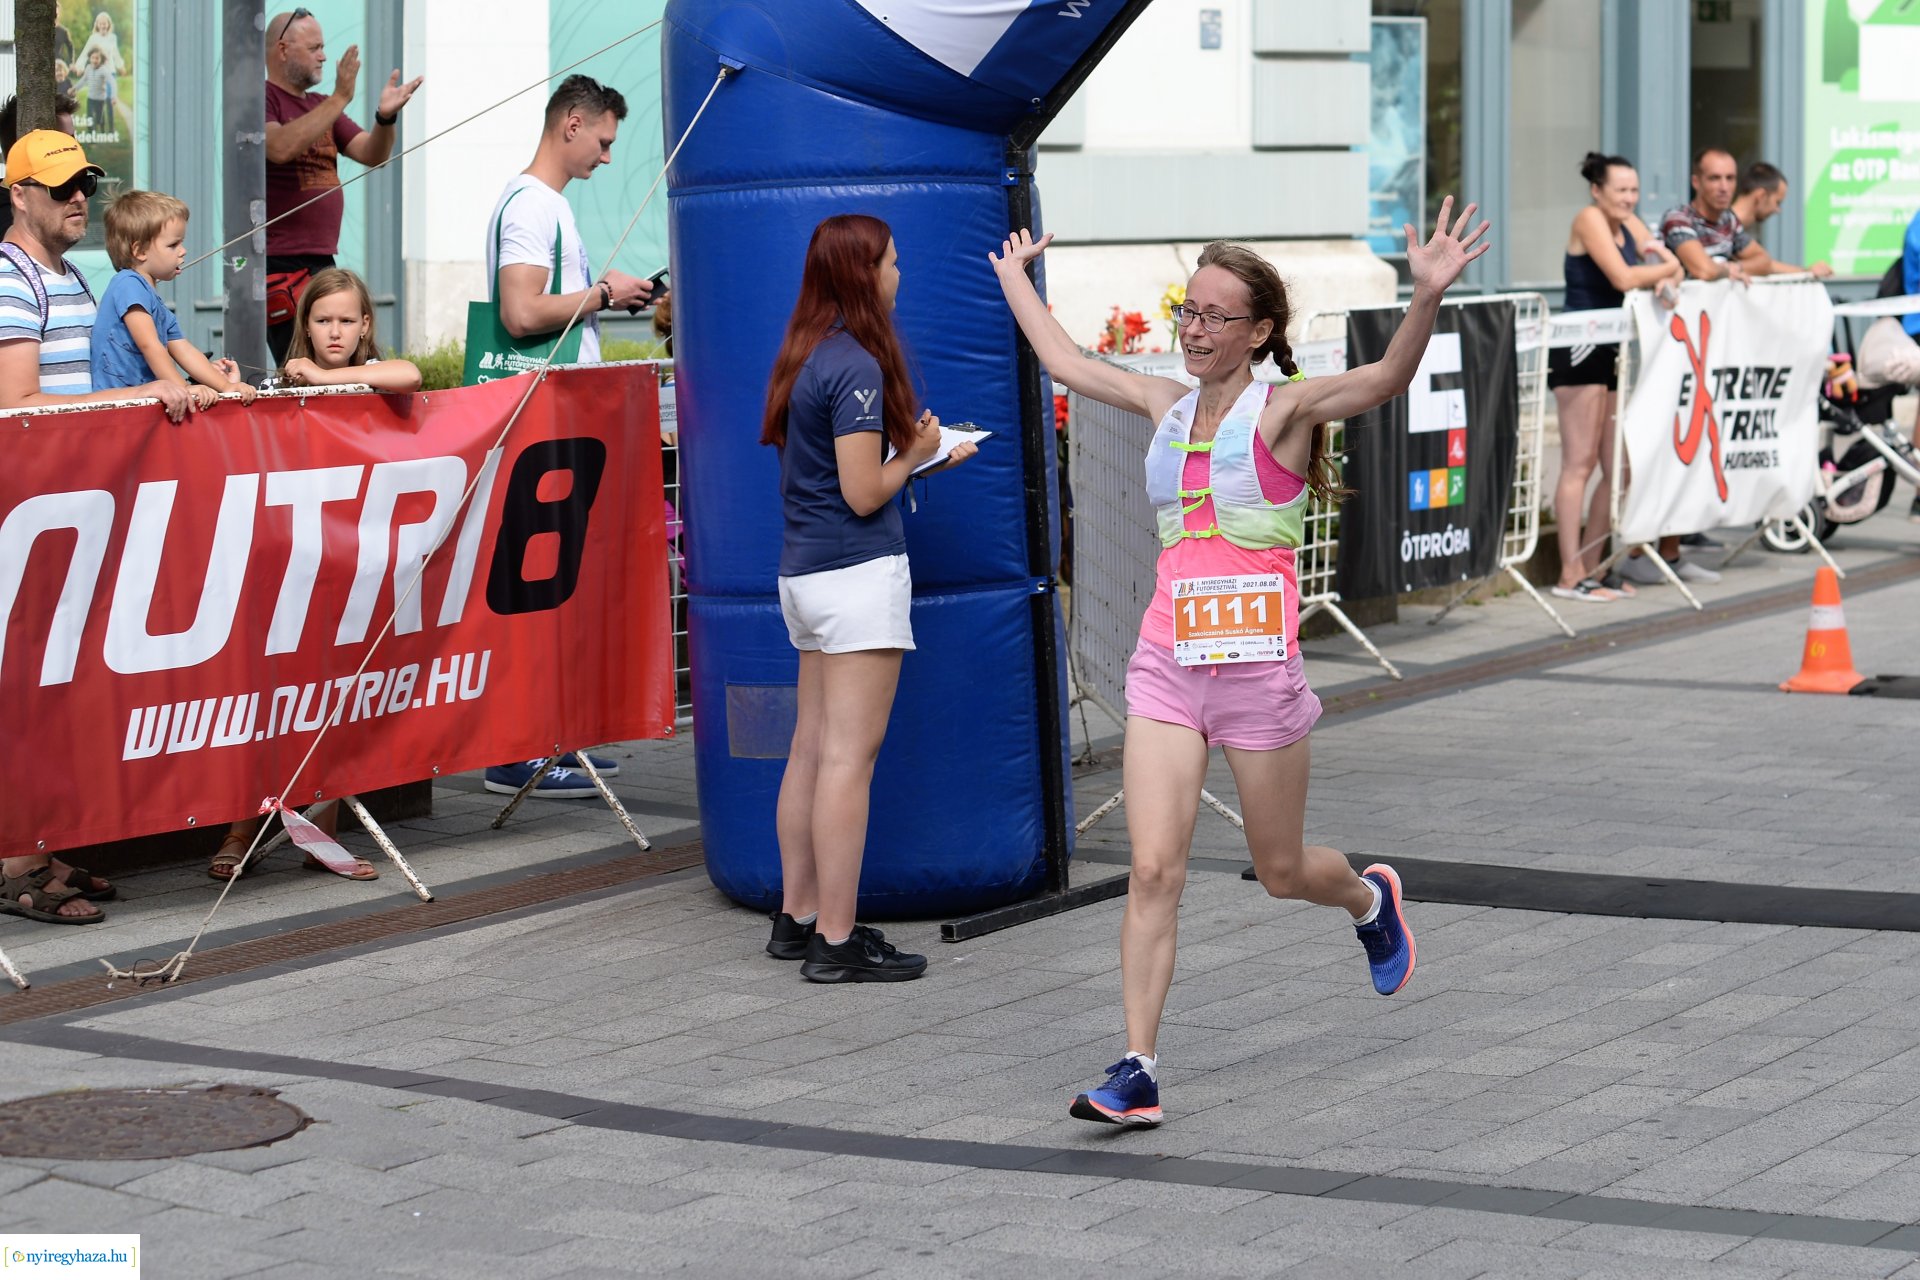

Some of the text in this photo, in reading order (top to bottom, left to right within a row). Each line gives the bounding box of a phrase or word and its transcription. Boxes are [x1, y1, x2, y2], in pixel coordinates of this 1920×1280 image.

[1853, 158, 1887, 180] OTP
[1720, 408, 1778, 441] TRAIL
[1401, 524, 1470, 562] ÖTPRÓBA
[1183, 595, 1267, 628] 1111
